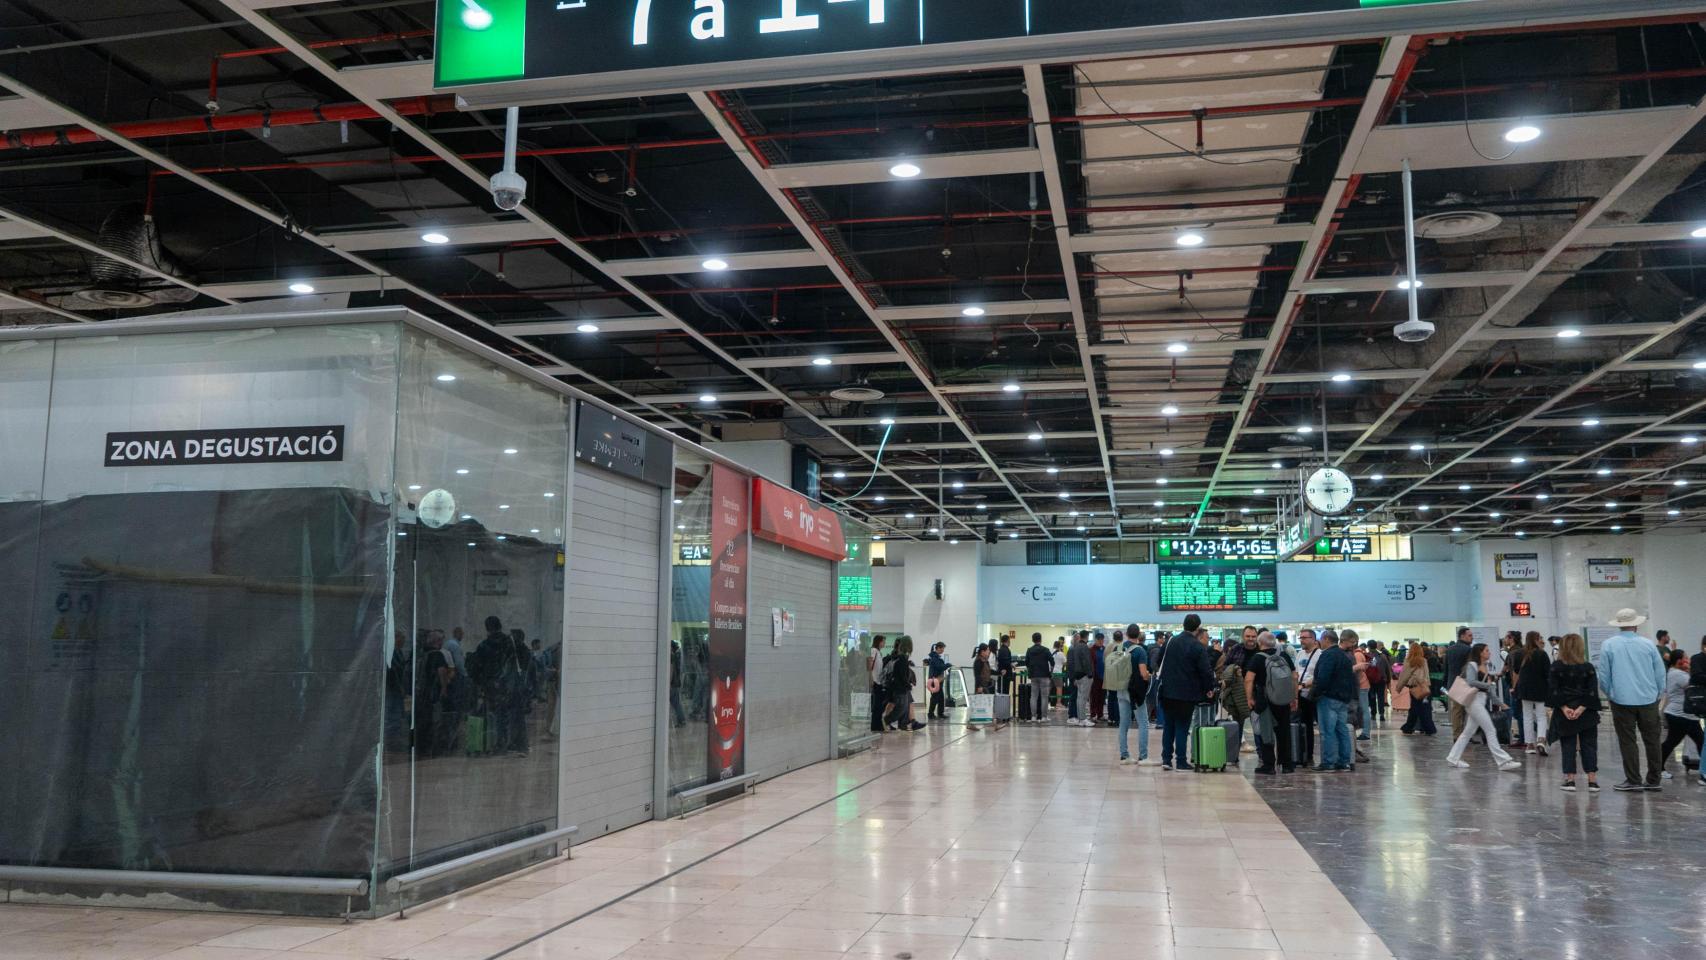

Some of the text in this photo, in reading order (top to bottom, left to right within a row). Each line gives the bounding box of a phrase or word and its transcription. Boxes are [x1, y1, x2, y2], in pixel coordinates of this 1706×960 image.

[690, 0, 725, 39] a
[110, 430, 337, 460] ZONA DEGUSTACIÓ
[800, 503, 814, 537] iryo
[1341, 539, 1351, 553] A
[1507, 567, 1535, 577] renfe
[1032, 586, 1040, 600] C
[1405, 584, 1415, 600] B
[721, 706, 734, 718] iryo
